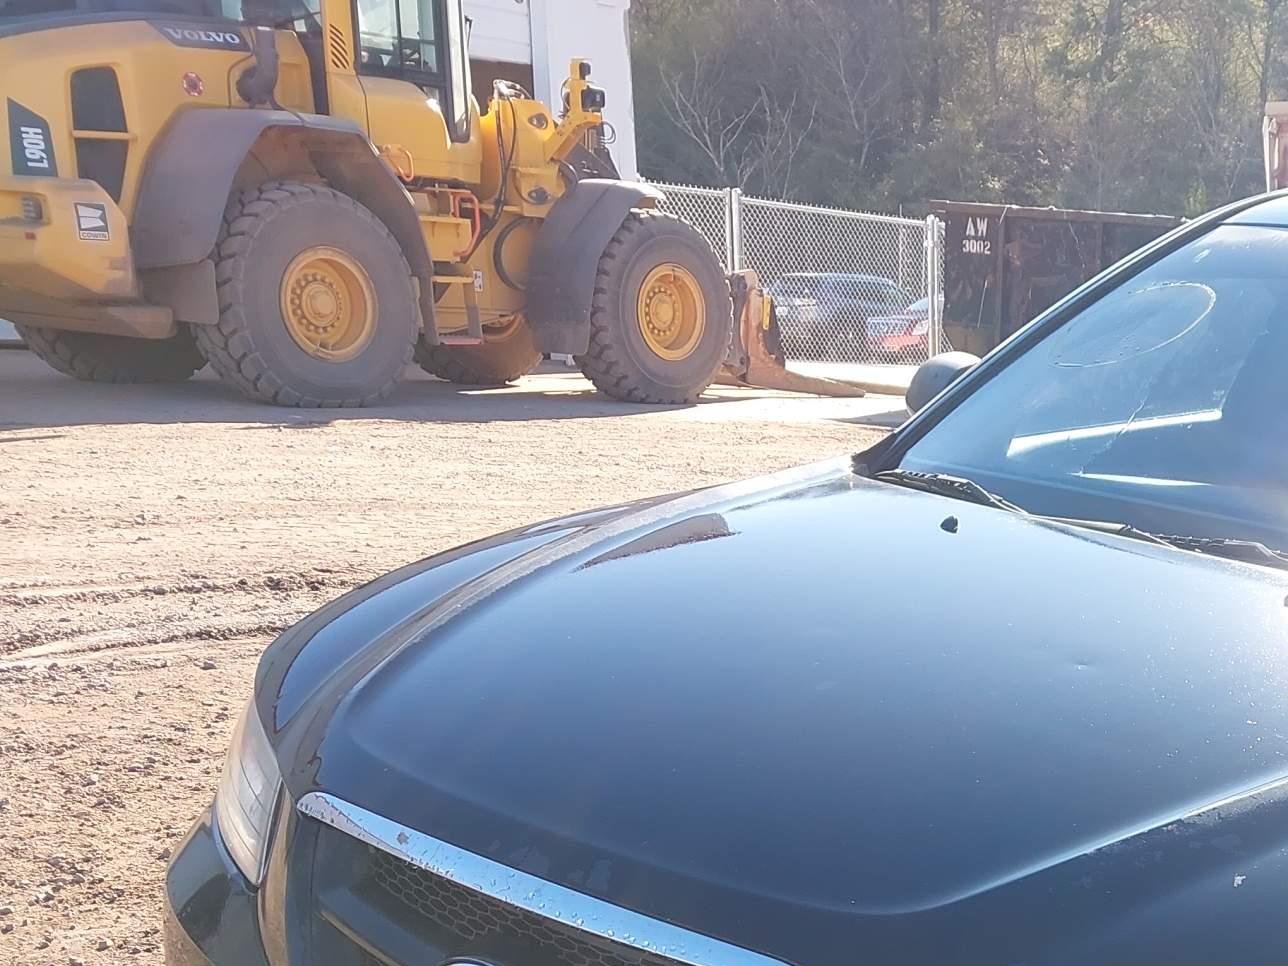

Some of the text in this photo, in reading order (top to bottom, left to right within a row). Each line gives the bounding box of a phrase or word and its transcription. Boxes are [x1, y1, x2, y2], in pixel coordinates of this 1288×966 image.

[164, 27, 240, 44] VOLVO
[20, 126, 49, 168] L90H
[81, 230, 108, 239] COWIN
[965, 217, 988, 236] AW
[962, 239, 991, 255] 3002
